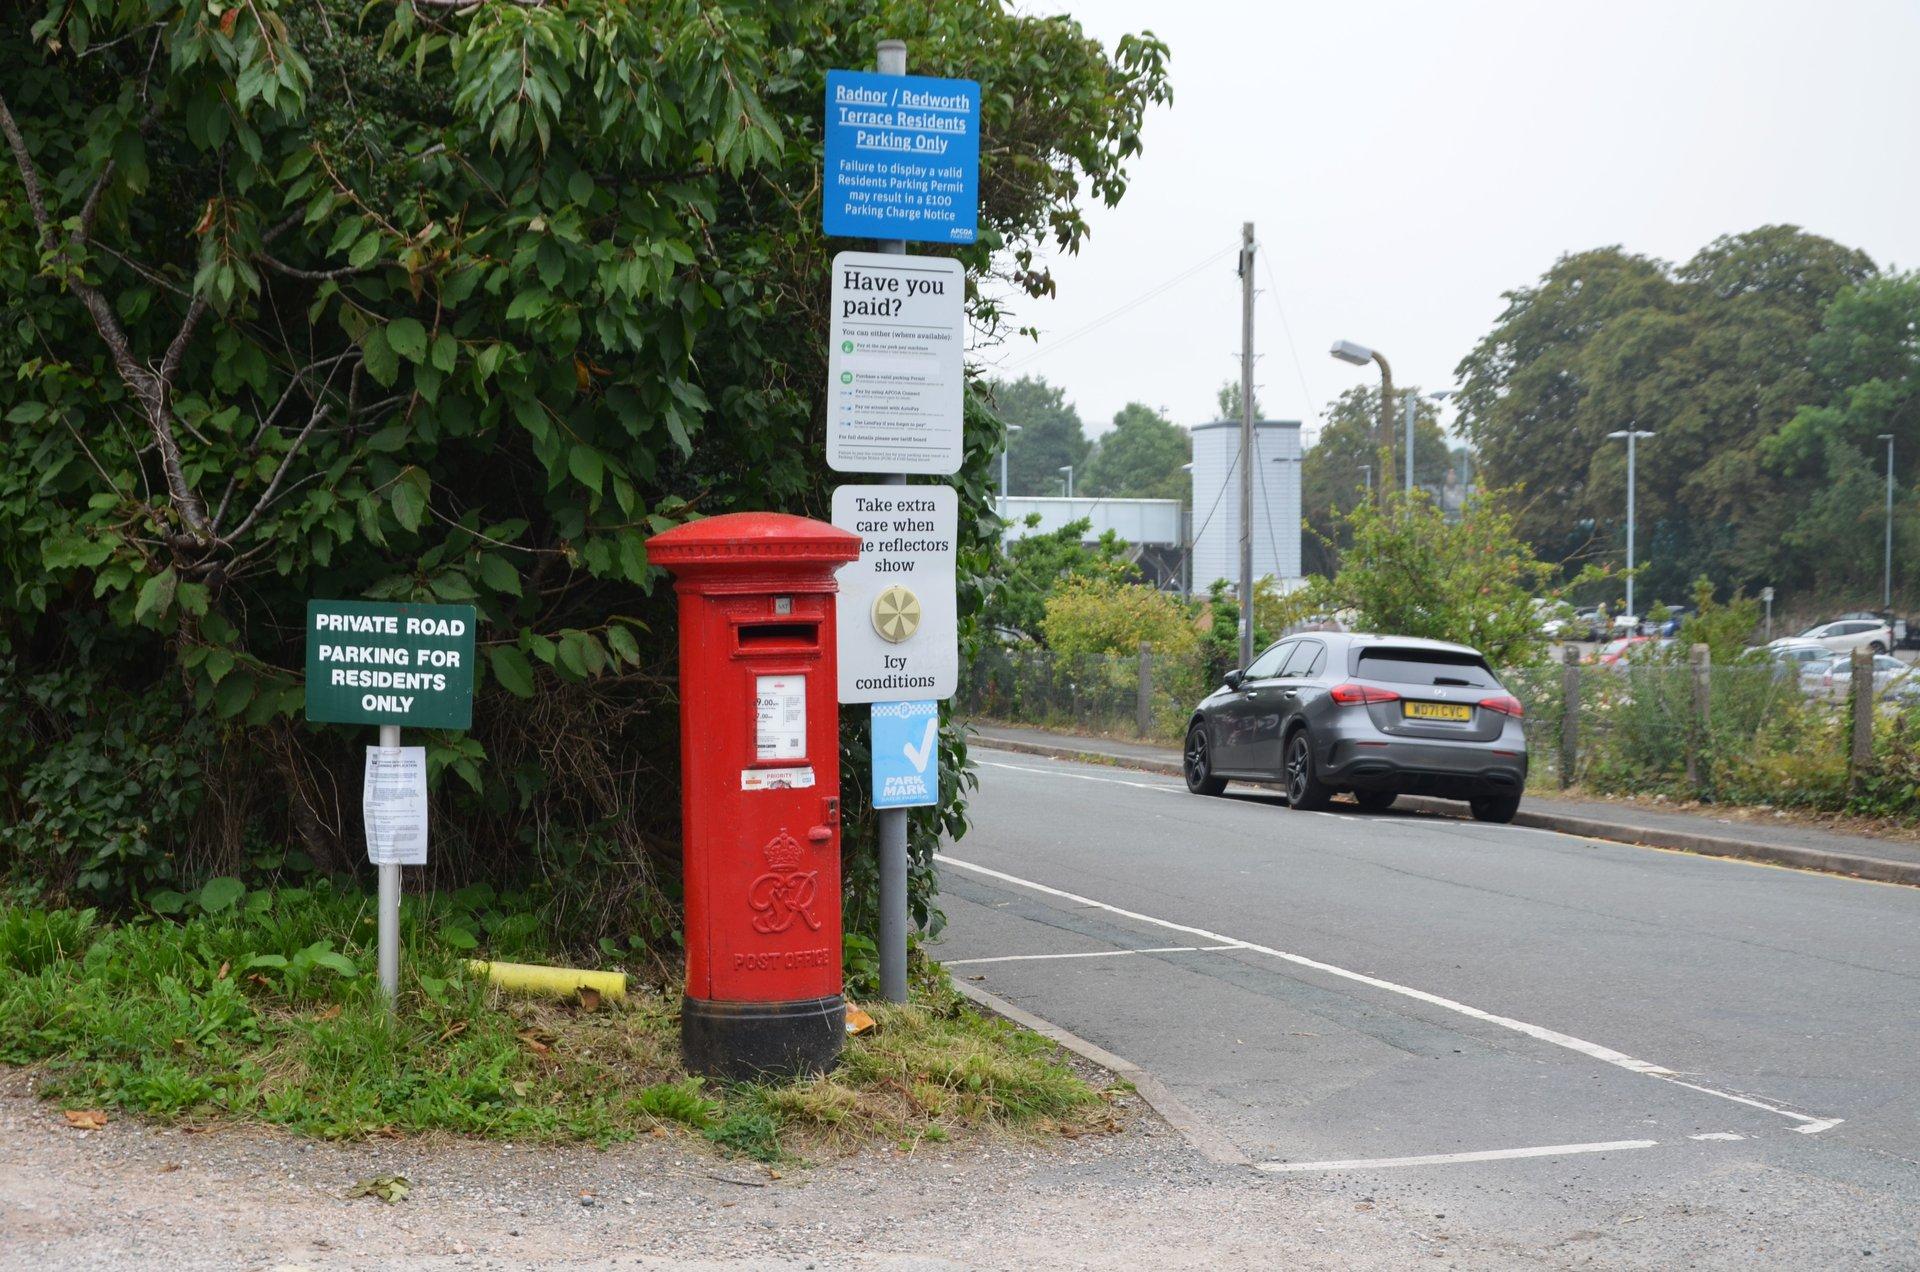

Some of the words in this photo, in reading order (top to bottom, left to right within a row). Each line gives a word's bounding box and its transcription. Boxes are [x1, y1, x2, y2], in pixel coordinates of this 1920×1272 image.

[836, 85, 887, 102] Radnor
[891, 88, 898, 106] /
[903, 90, 970, 109] Redworth
[839, 107, 892, 125] Terrace
[898, 112, 966, 131] Residents
[857, 131, 911, 150] Parking
[916, 135, 948, 154] Only
[840, 160, 874, 172] Failure
[877, 162, 887, 173] to
[891, 162, 926, 177] display
[929, 167, 935, 176] a
[938, 168, 962, 178] valid
[838, 176, 887, 188] Residents
[890, 178, 928, 192] Parking
[931, 180, 963, 193] Permit
[850, 192, 870, 203] may
[873, 191, 901, 203] result
[905, 192, 914, 204] in
[917, 196, 922, 205] a
[926, 194, 952, 206] £100
[845, 204, 883, 218] Parking
[886, 206, 920, 220] Charge
[924, 209, 955, 220] Notice
[844, 271, 899, 292] Have
[906, 280, 944, 297] you
[843, 298, 902, 318] paid?
[856, 498, 892, 512] Take
[897, 499, 935, 512] extra
[856, 521, 888, 532] care
[893, 519, 934, 532] when
[879, 538, 948, 551] reflectors
[875, 559, 915, 572] show
[316, 613, 398, 634] PRIVATE
[407, 618, 465, 636] ROAD
[319, 645, 408, 665] PARKING
[418, 650, 460, 668] FOR
[884, 655, 907, 671] Icy
[332, 669, 446, 691] RESIDENTS
[856, 675, 935, 690] conditions
[362, 695, 414, 712] ONLY
[886, 776, 924, 785] PARK
[883, 784, 927, 796] MARK
[734, 952, 780, 970] POST
[785, 948, 829, 969] OFFICE
